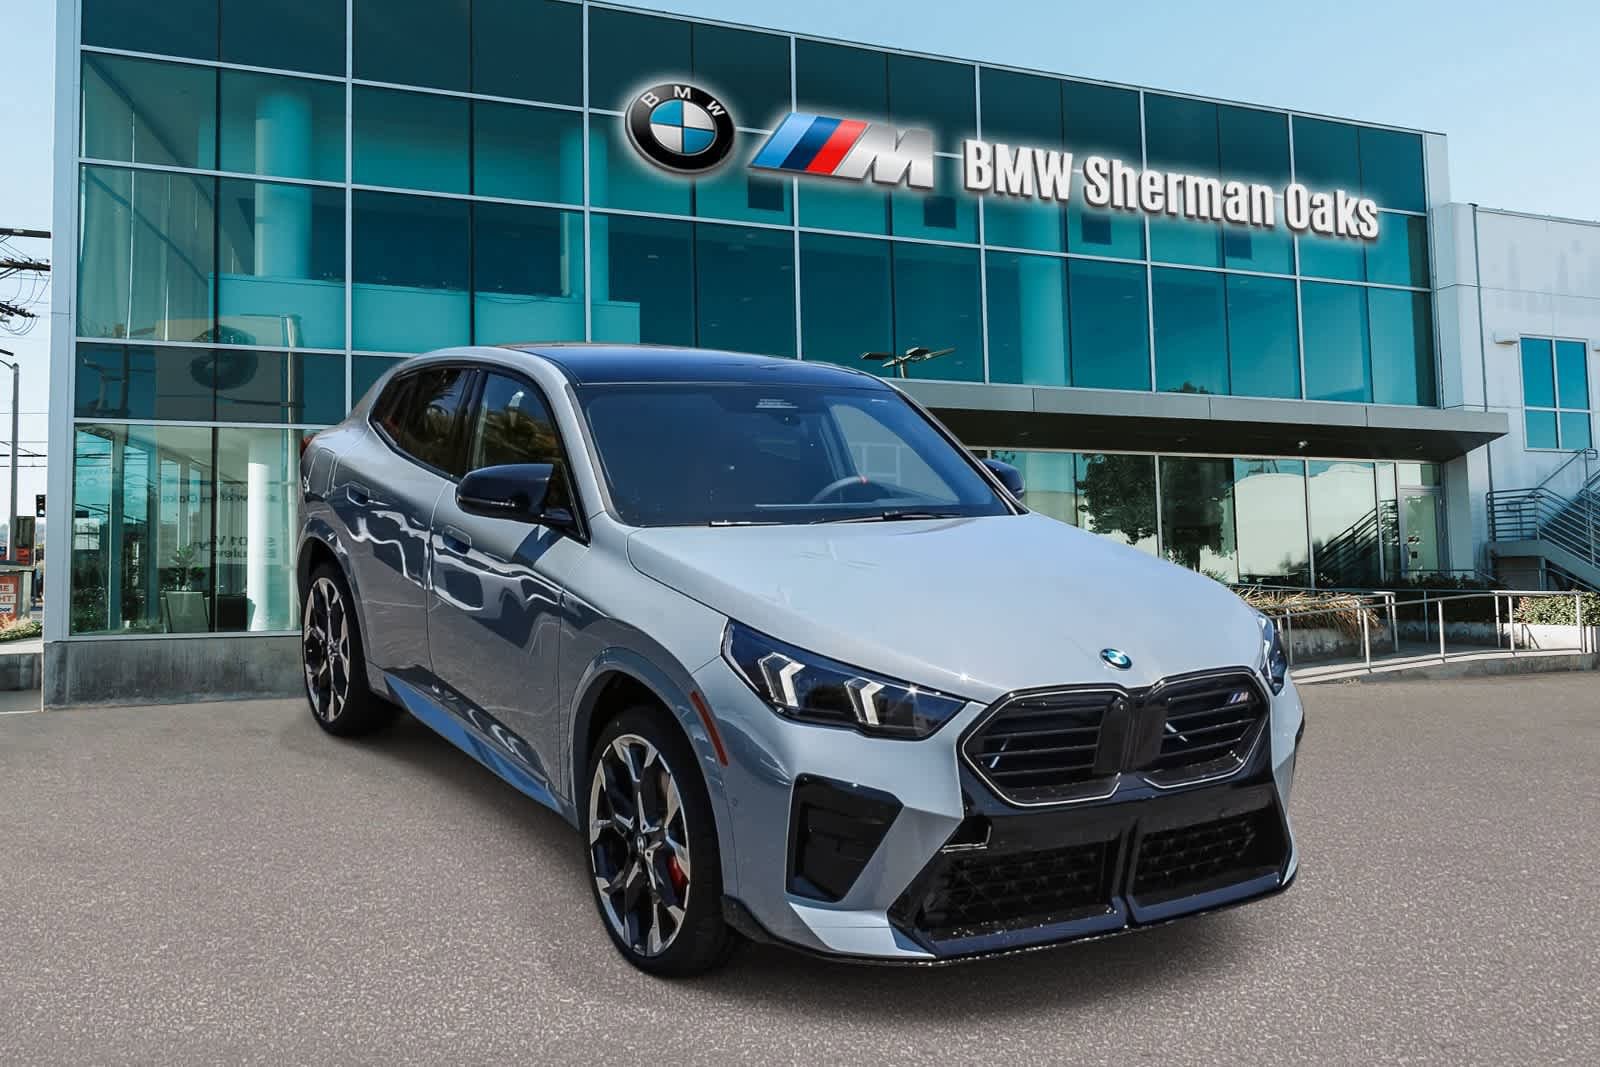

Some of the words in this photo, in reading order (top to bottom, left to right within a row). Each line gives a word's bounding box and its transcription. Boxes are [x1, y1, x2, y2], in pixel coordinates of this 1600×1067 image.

[640, 85, 726, 117] BMW
[963, 139, 1073, 202] BMW
[1083, 156, 1275, 228] Sherman
[1284, 183, 1379, 240] Oaks
